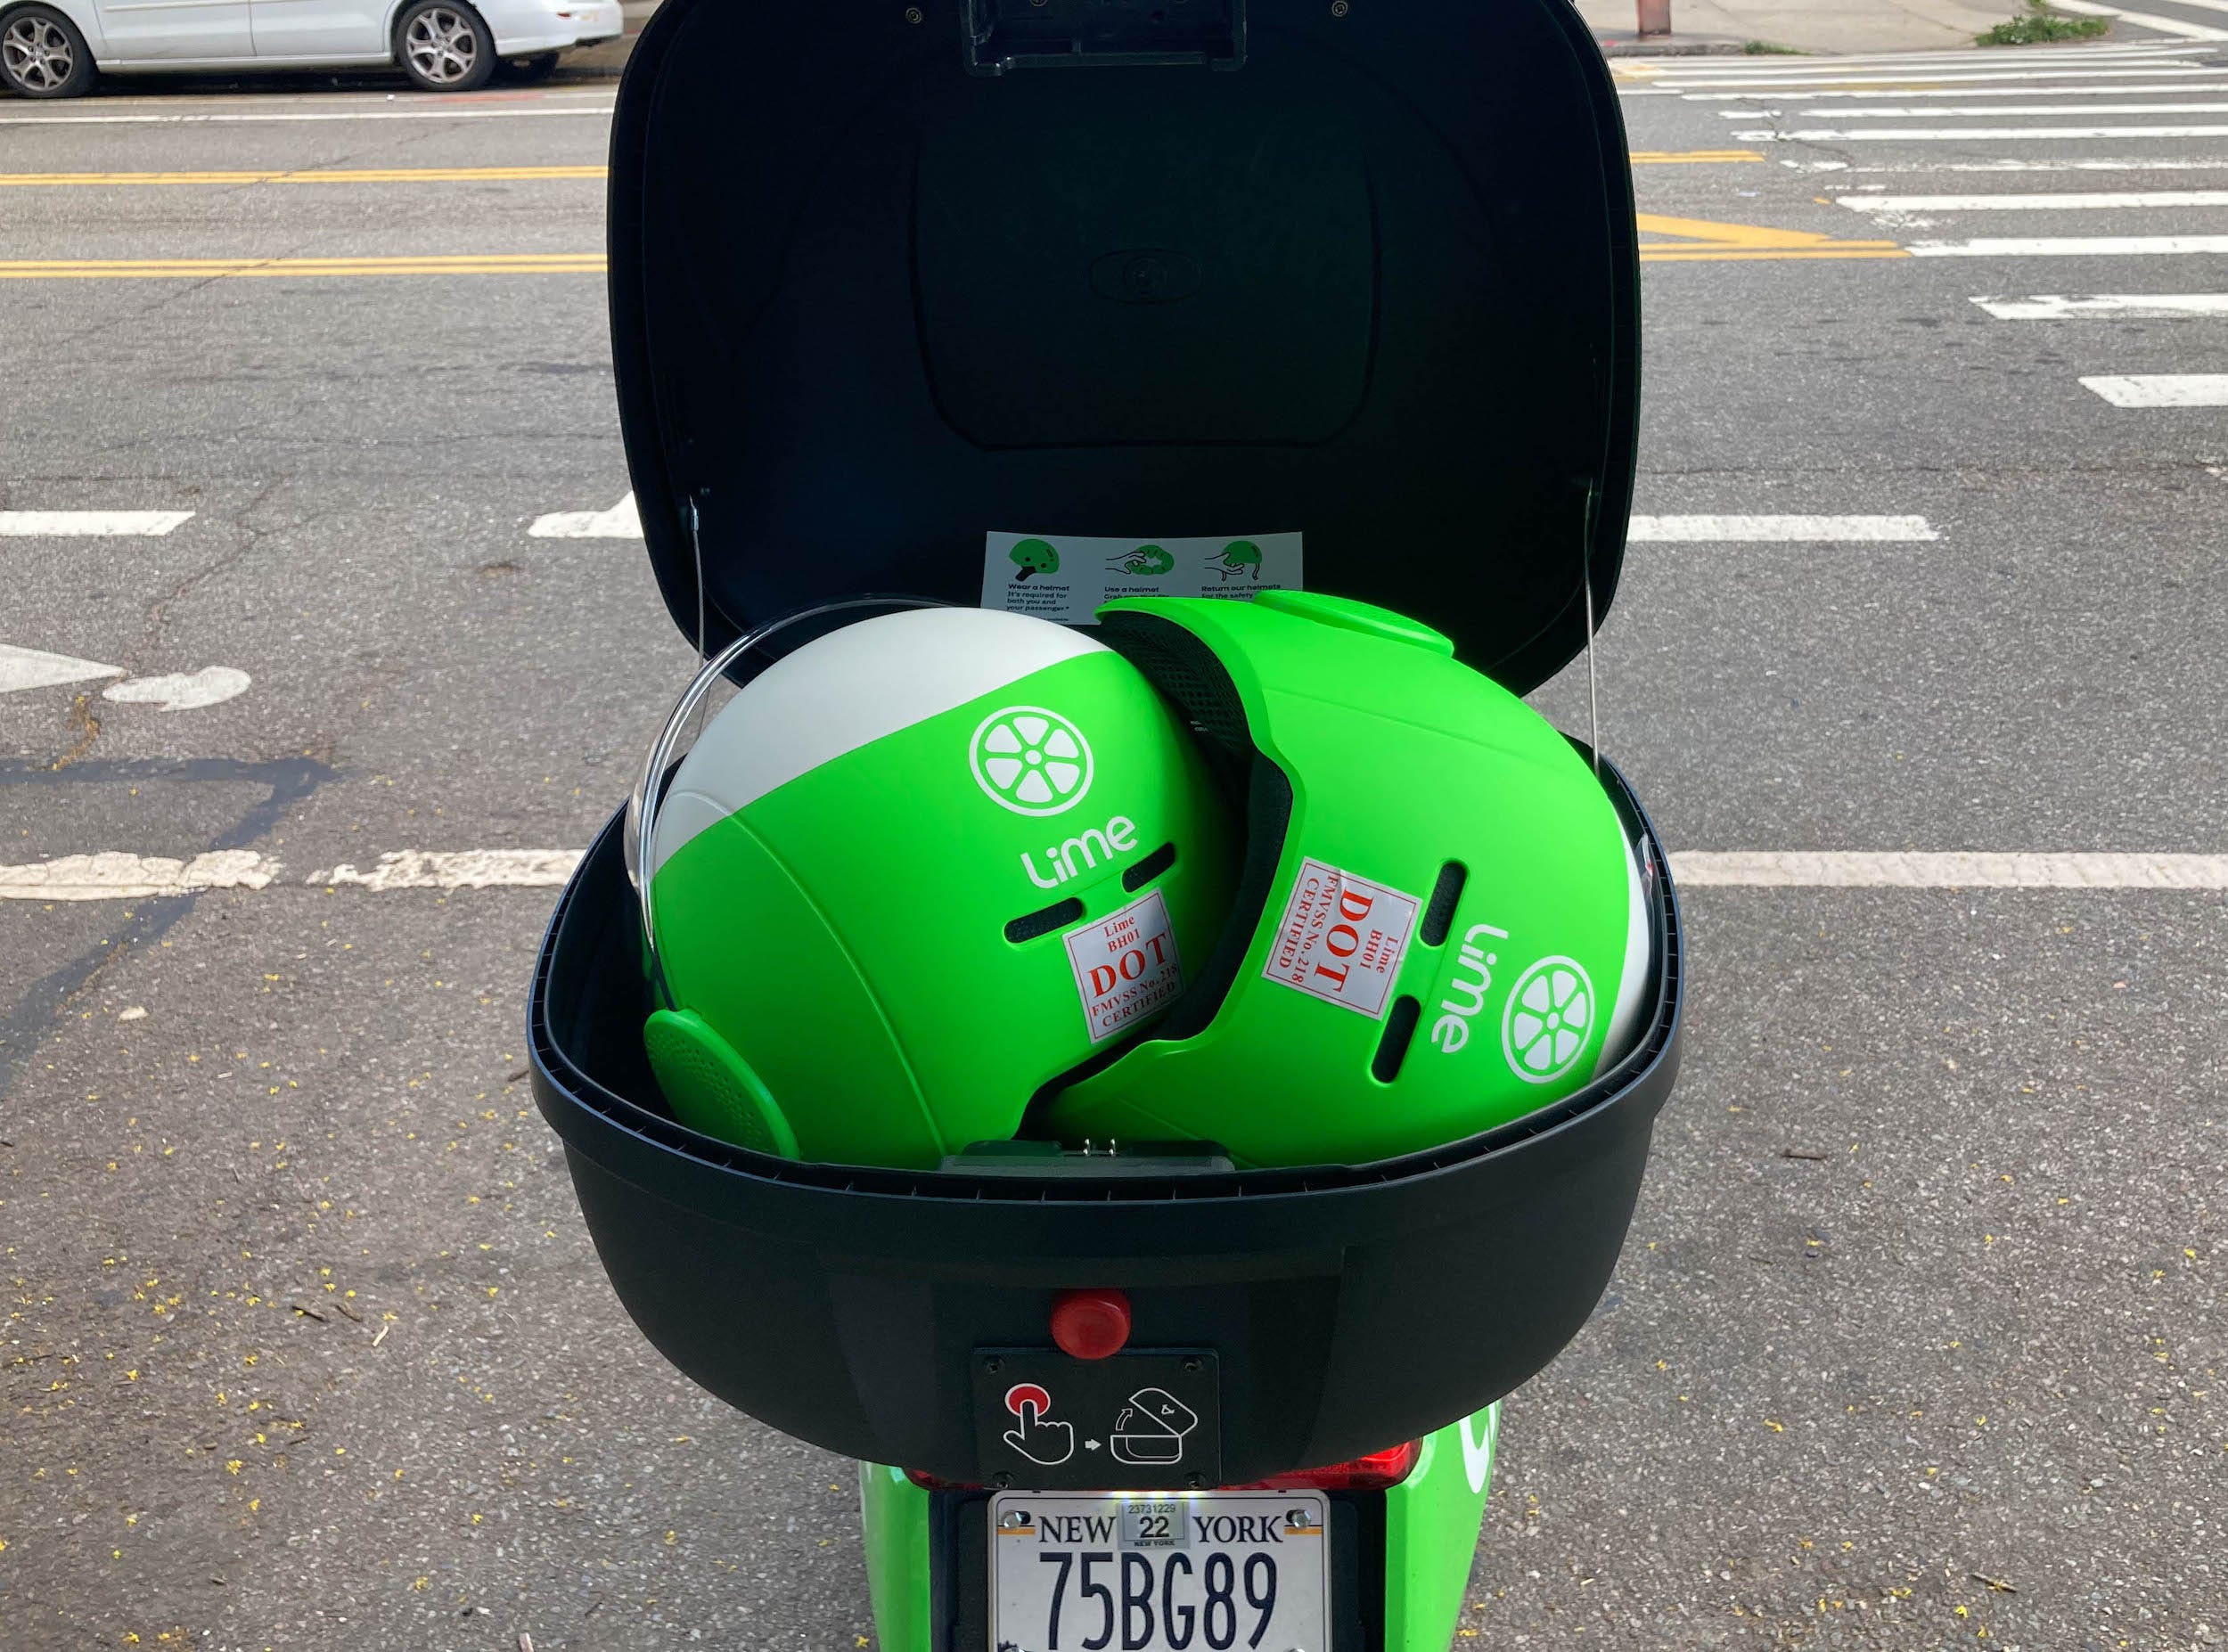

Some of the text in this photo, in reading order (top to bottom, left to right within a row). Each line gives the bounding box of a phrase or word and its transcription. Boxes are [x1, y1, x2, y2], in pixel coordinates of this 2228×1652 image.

[1021, 592, 1054, 601] required
[1020, 815, 1138, 889] Lime
[1311, 873, 1339, 929] FMVSS
[1104, 915, 1134, 937] Lime
[1107, 928, 1141, 953] BH01
[1279, 878, 1320, 969] CERTIFIED
[1314, 887, 1374, 993] DOT
[1085, 932, 1167, 999] DOT
[1359, 928, 1383, 969] BH01
[1376, 936, 1399, 974] Lime
[1091, 986, 1138, 1017] FMVSS
[1102, 981, 1175, 1027] CERTIFIED
[1430, 923, 1509, 1054] Lime
[1039, 1516, 1283, 1543] NEW YORK
[1127, 1503, 1176, 1515] 23731229
[1139, 1516, 1170, 1538] 22
[1039, 1551, 1278, 1651] 75BG89
